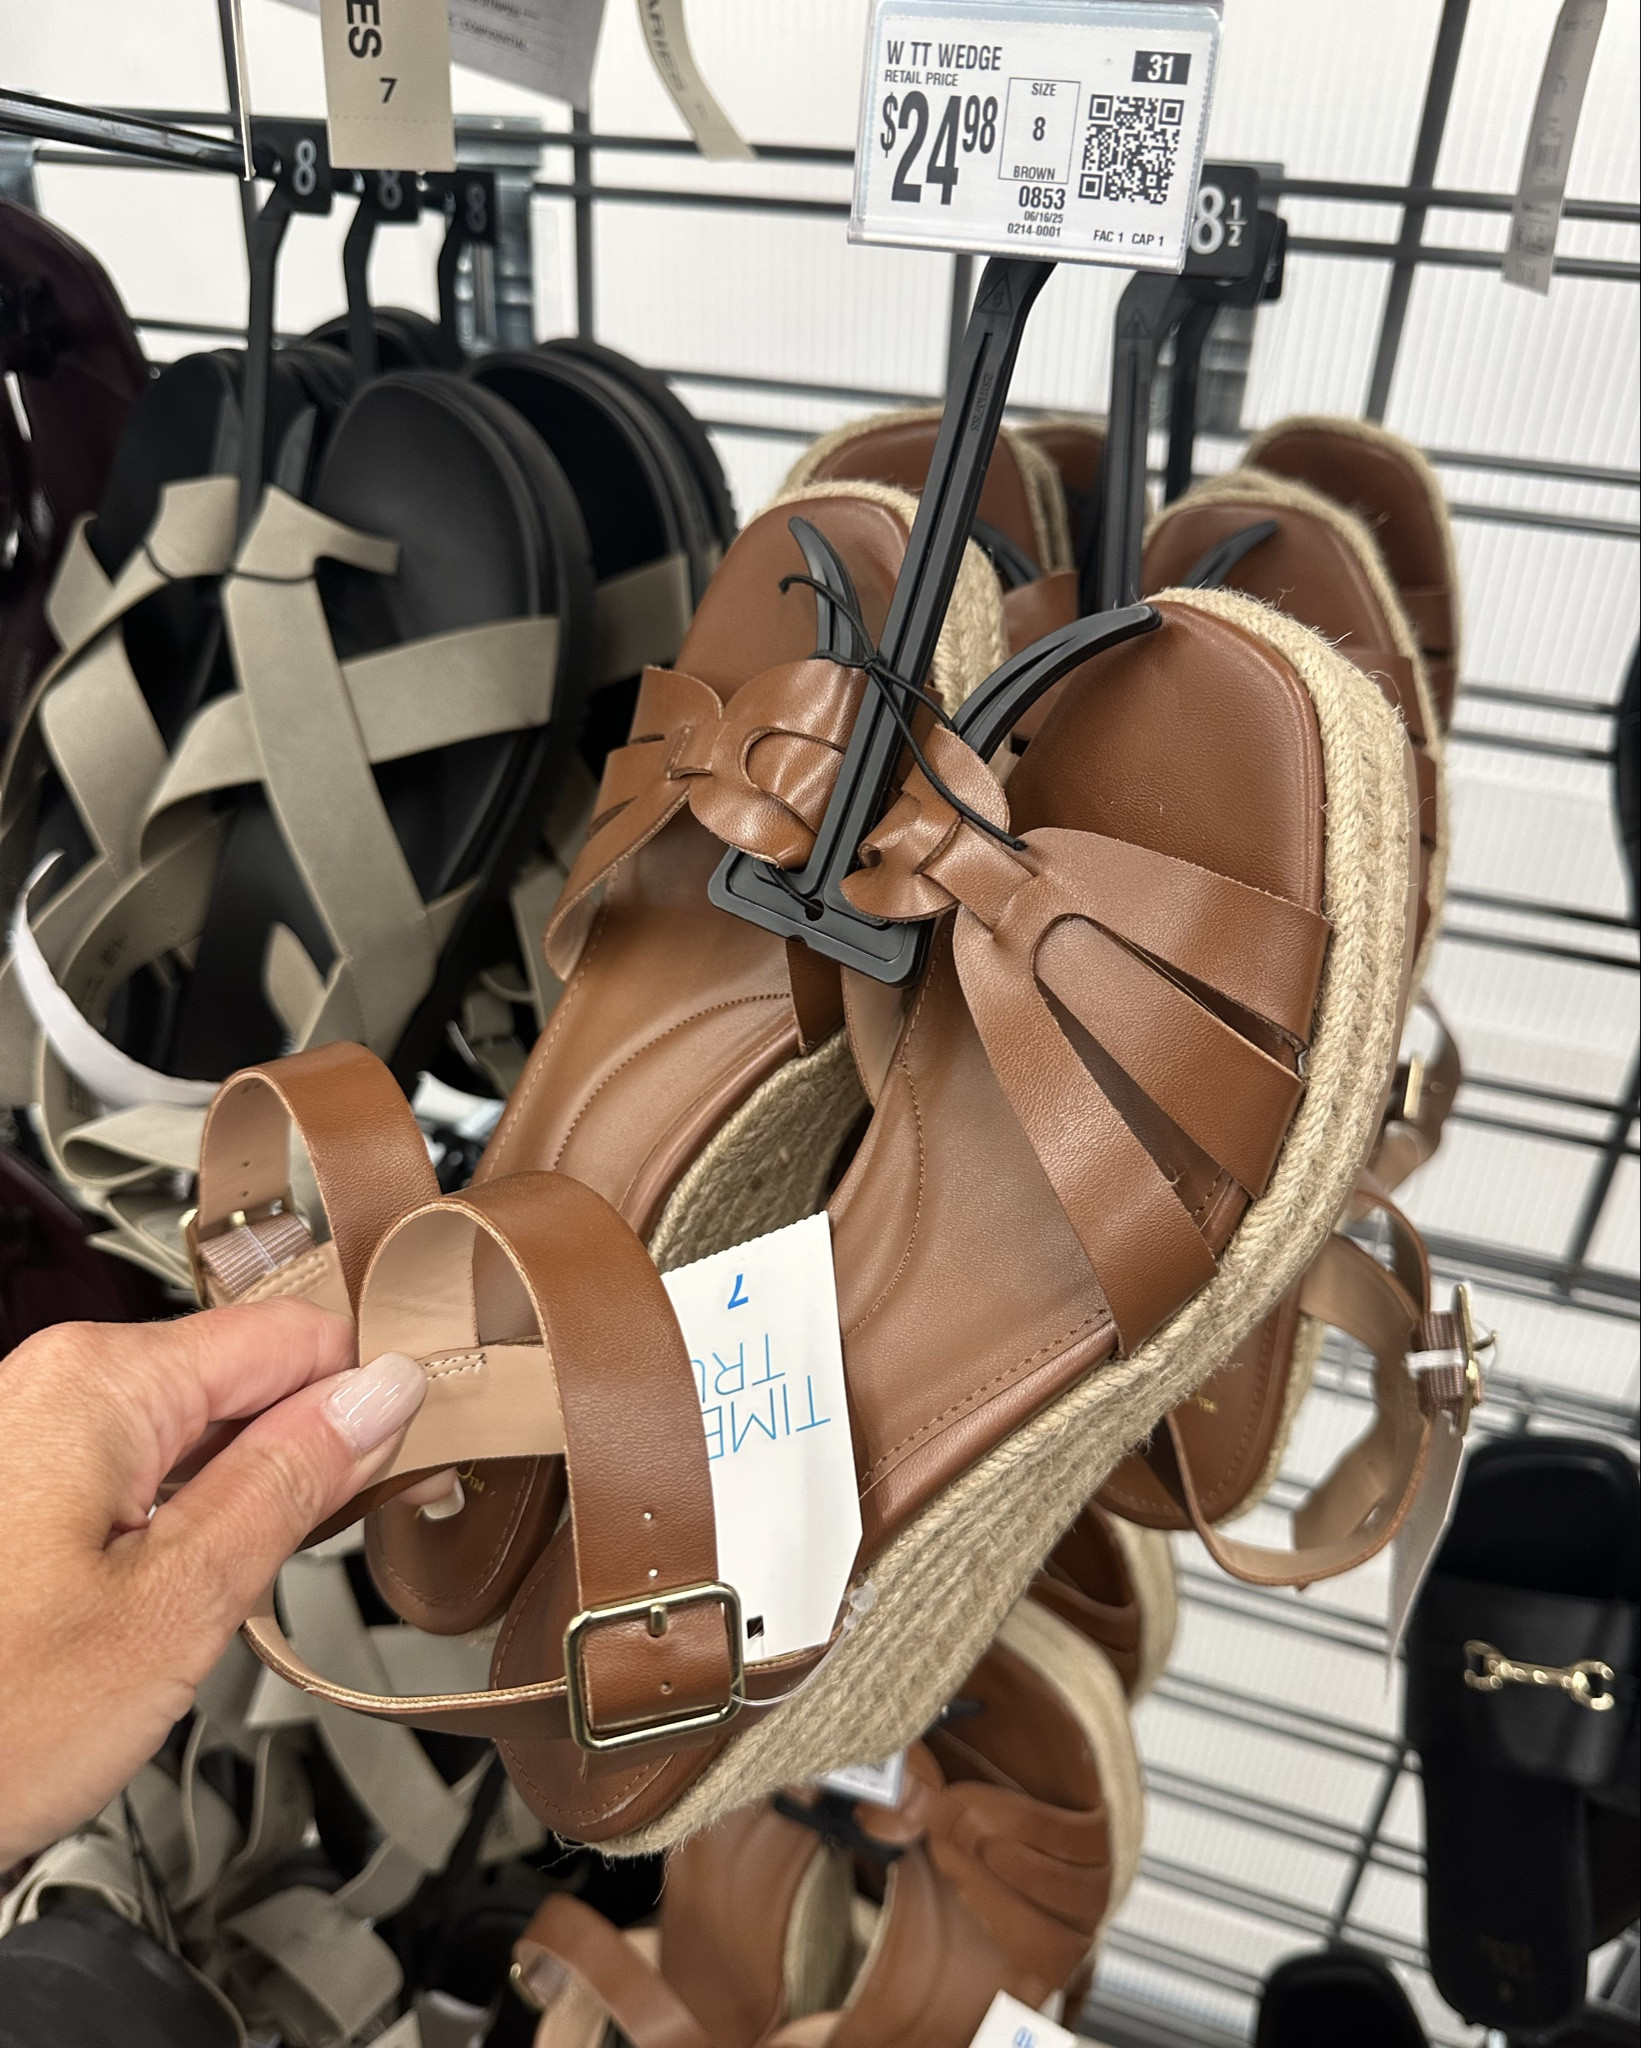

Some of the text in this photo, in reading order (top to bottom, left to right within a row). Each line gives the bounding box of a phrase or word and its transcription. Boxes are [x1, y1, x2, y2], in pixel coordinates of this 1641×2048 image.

[887, 39, 1003, 71] W TT WEDGE
[1147, 54, 1175, 81] 31
[379, 77, 398, 103] 7
[884, 69, 959, 87] RETAIL PRICE
[1031, 82, 1057, 97] SIZE
[1032, 116, 1046, 142] 8
[292, 138, 317, 196] 8
[1013, 165, 1056, 181] BROWN
[465, 181, 488, 234] 8
[1018, 185, 1066, 210] 0853
[1007, 222, 1061, 237] 0214-0001
[1024, 211, 1064, 224] 06/16/25
[1093, 229, 1164, 247] FAC 1 CAP 1
[727, 1273, 749, 1310] 7
[701, 1374, 831, 1461] TIME
